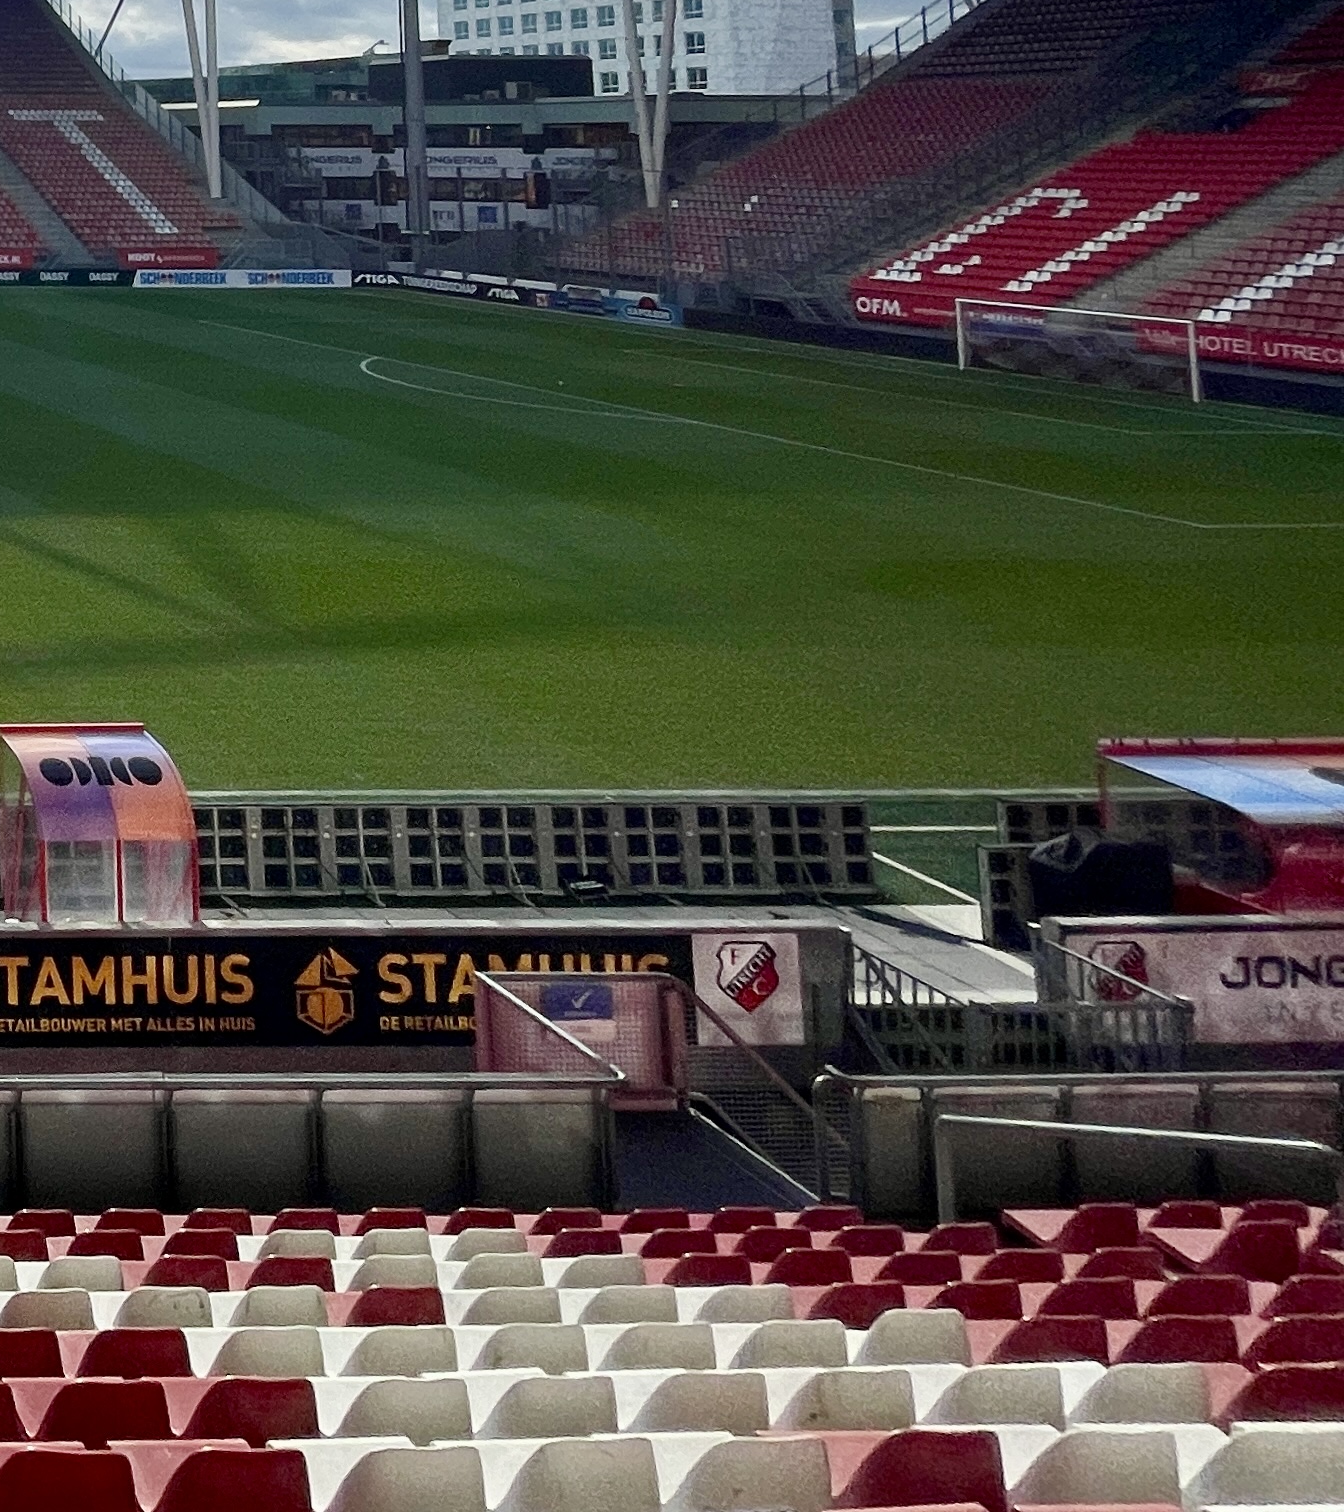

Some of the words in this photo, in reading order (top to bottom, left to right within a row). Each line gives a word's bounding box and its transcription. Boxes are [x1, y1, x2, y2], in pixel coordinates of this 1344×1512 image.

[354, 274, 400, 285] STIGA
[730, 947, 739, 966] F
[752, 977, 769, 995] C
[110, 1017, 143, 1032] MET
[146, 1016, 195, 1032] ALLES
[199, 1016, 215, 1032] IN
[219, 1016, 256, 1031] HUIS
[379, 1015, 402, 1032] DE
[404, 1014, 477, 1032] RETAILBO
